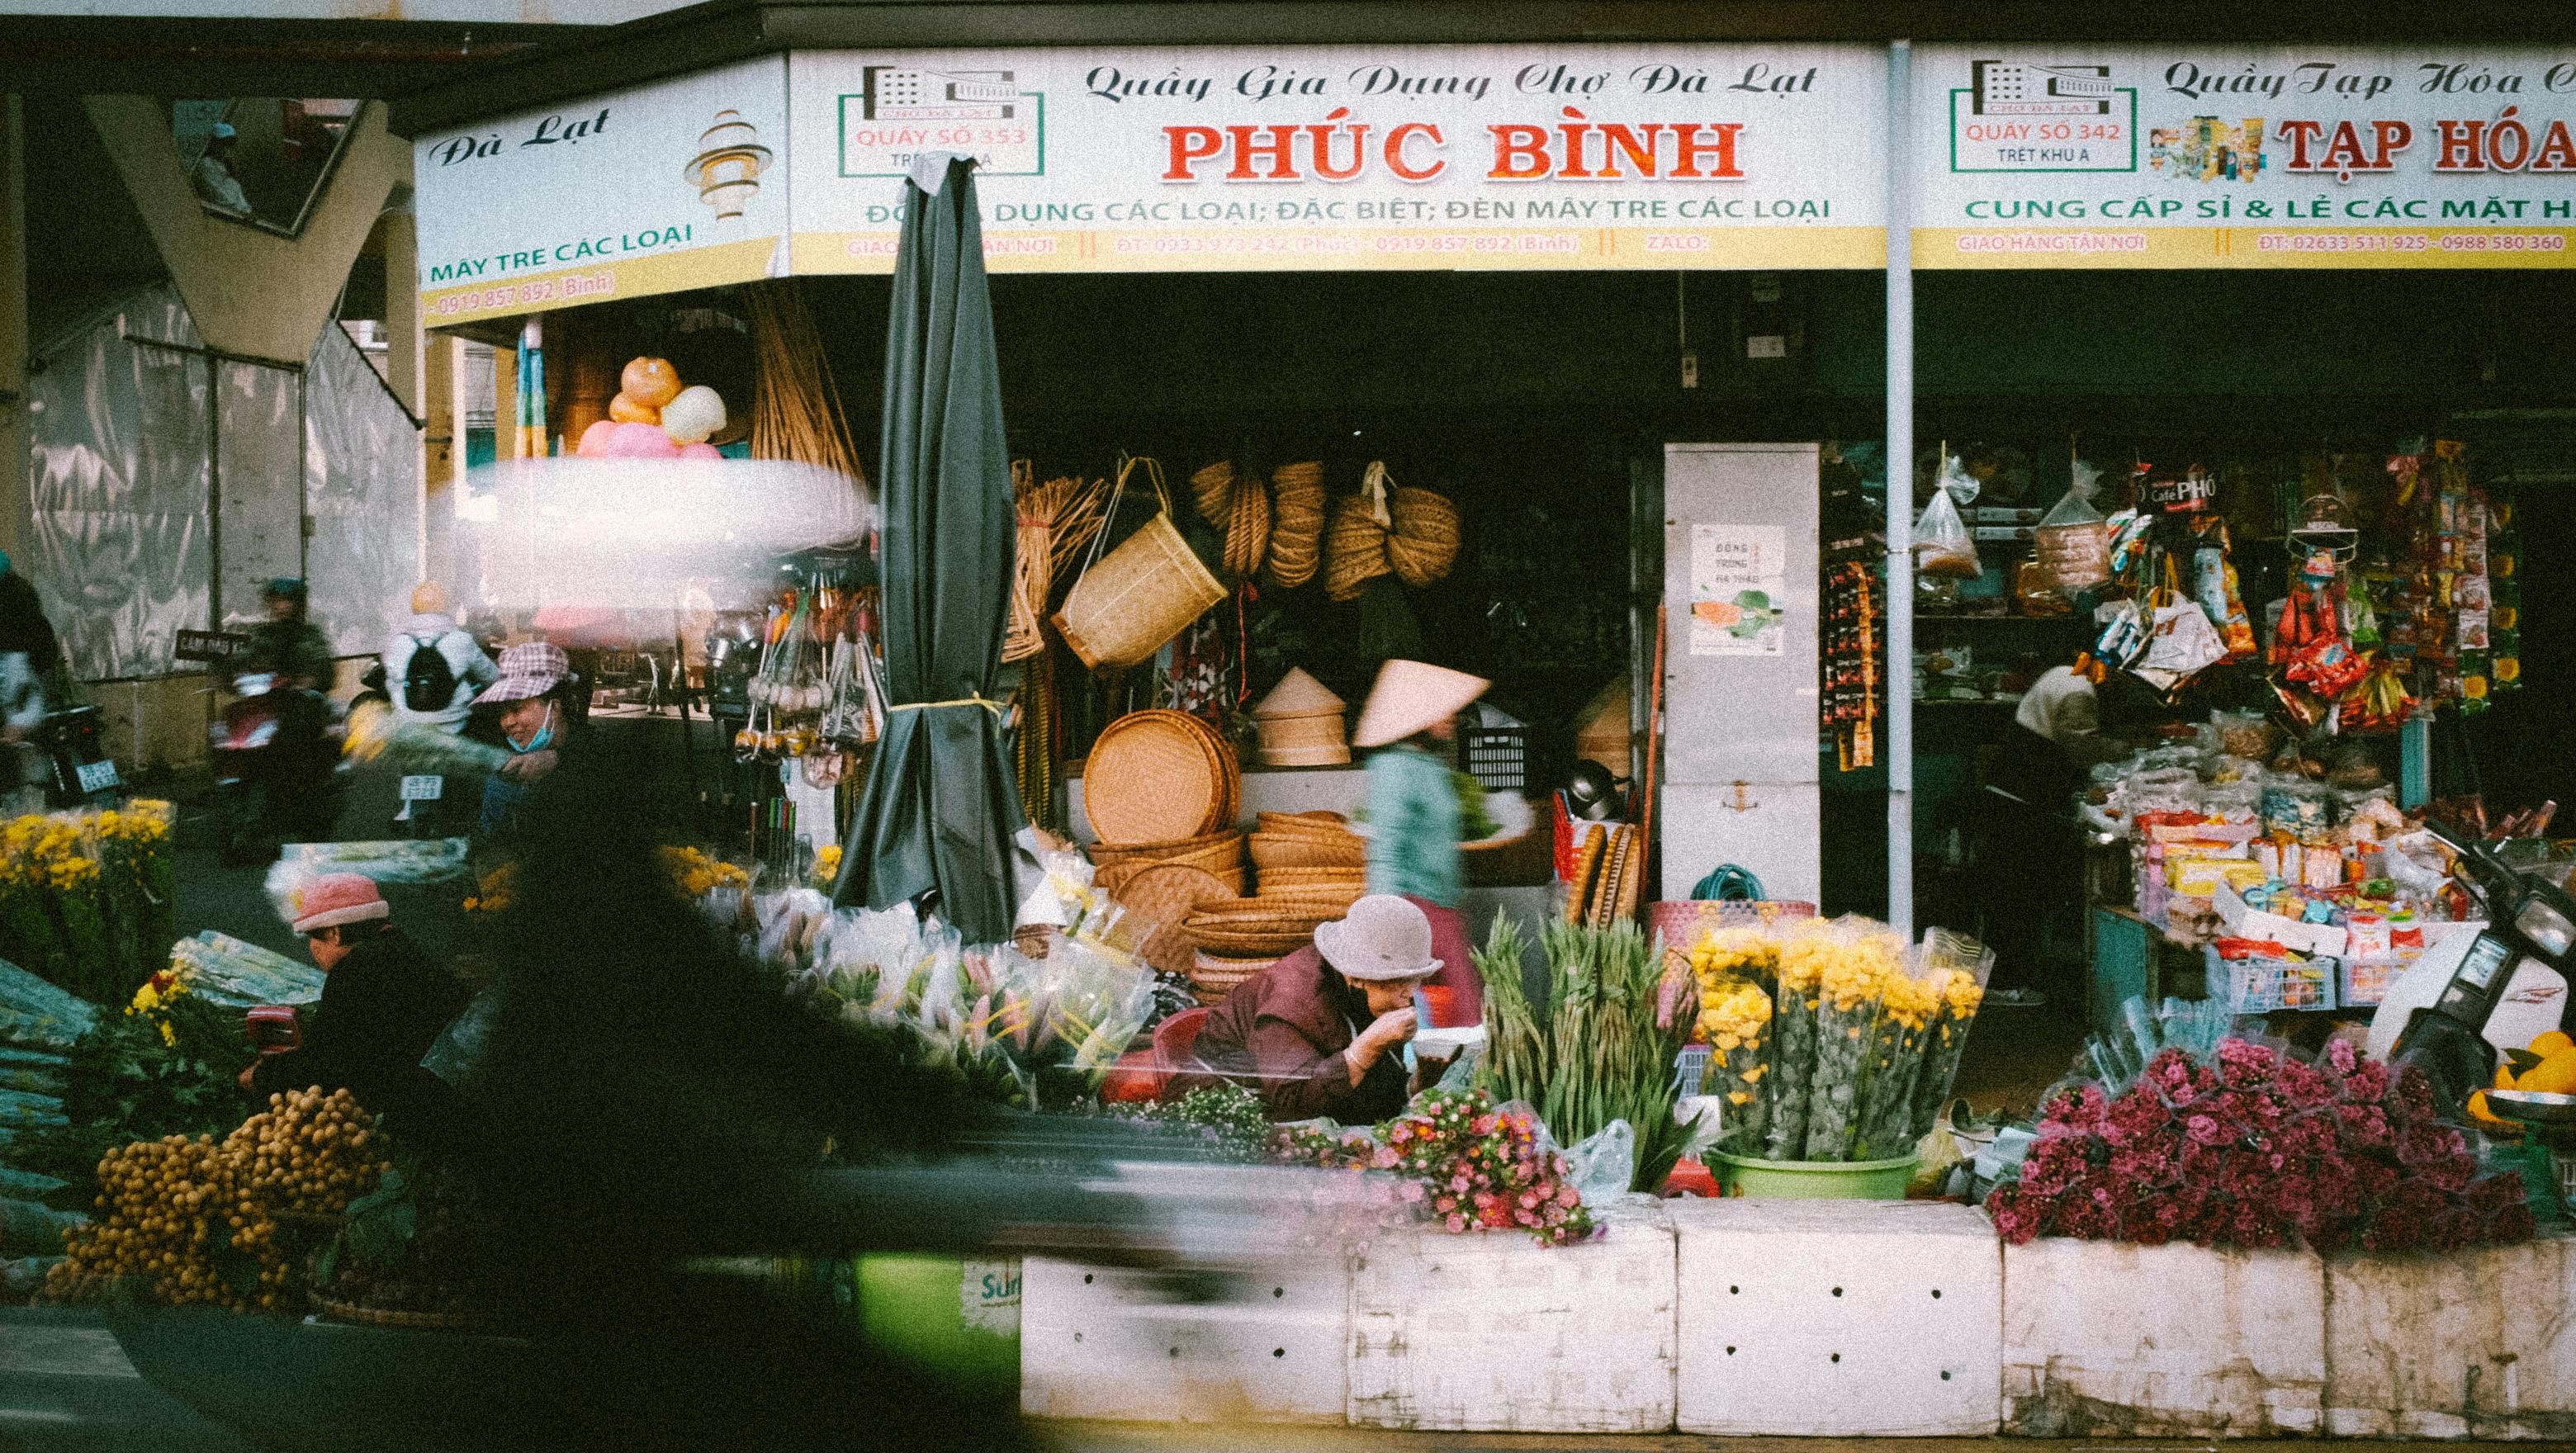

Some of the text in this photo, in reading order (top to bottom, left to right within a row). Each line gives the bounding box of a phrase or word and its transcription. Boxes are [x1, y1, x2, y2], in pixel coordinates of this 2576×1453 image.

[1086, 62, 1818, 103] Quầy Gia Dụng Chợ Đà Lạt
[2164, 61, 2286, 100] Quầy
[2294, 62, 2394, 100] Tạp
[2417, 62, 2523, 94] Hóa
[429, 108, 610, 167] Đà Lạt
[981, 128, 1025, 144] 353
[1162, 105, 1744, 180] PHÚC BÌNH
[2081, 124, 2120, 141] 342
[2041, 149, 2073, 162] KHU
[2080, 149, 2090, 162] A
[2277, 120, 2412, 182] TẠP
[996, 203, 1094, 226] DỤNG
[1105, 198, 1170, 221] CÁC
[1276, 197, 1346, 225] ĐẶC
[1446, 197, 1515, 219] ĐÈN
[1526, 196, 1598, 219] MÂY
[1608, 199, 1668, 219] TRE
[1679, 196, 1745, 219] CÁC
[1755, 199, 1830, 224] LOẠI
[1965, 200, 2086, 219] CUNG
[2100, 193, 2183, 219] CẤP
[2244, 200, 2273, 219] &
[2286, 193, 2332, 219] LẺ
[2345, 196, 2427, 219] CÁC
[2441, 195, 2531, 224] MẶT
[430, 224, 692, 283] MÂY TRE CÁC LOẠI
[1431, 236, 1468, 251] 857
[1475, 235, 1512, 250] 892
[1959, 235, 2005, 250] GIAO
[2293, 235, 2350, 250] 02633
[2356, 235, 2386, 250] 511
[2394, 235, 2426, 250] 925
[2441, 235, 2486, 250] 0988
[2493, 235, 2524, 250] 580
[2530, 235, 2563, 250] 360
[438, 292, 480, 316] 0919
[484, 286, 517, 308] 857
[522, 280, 554, 302] 892
